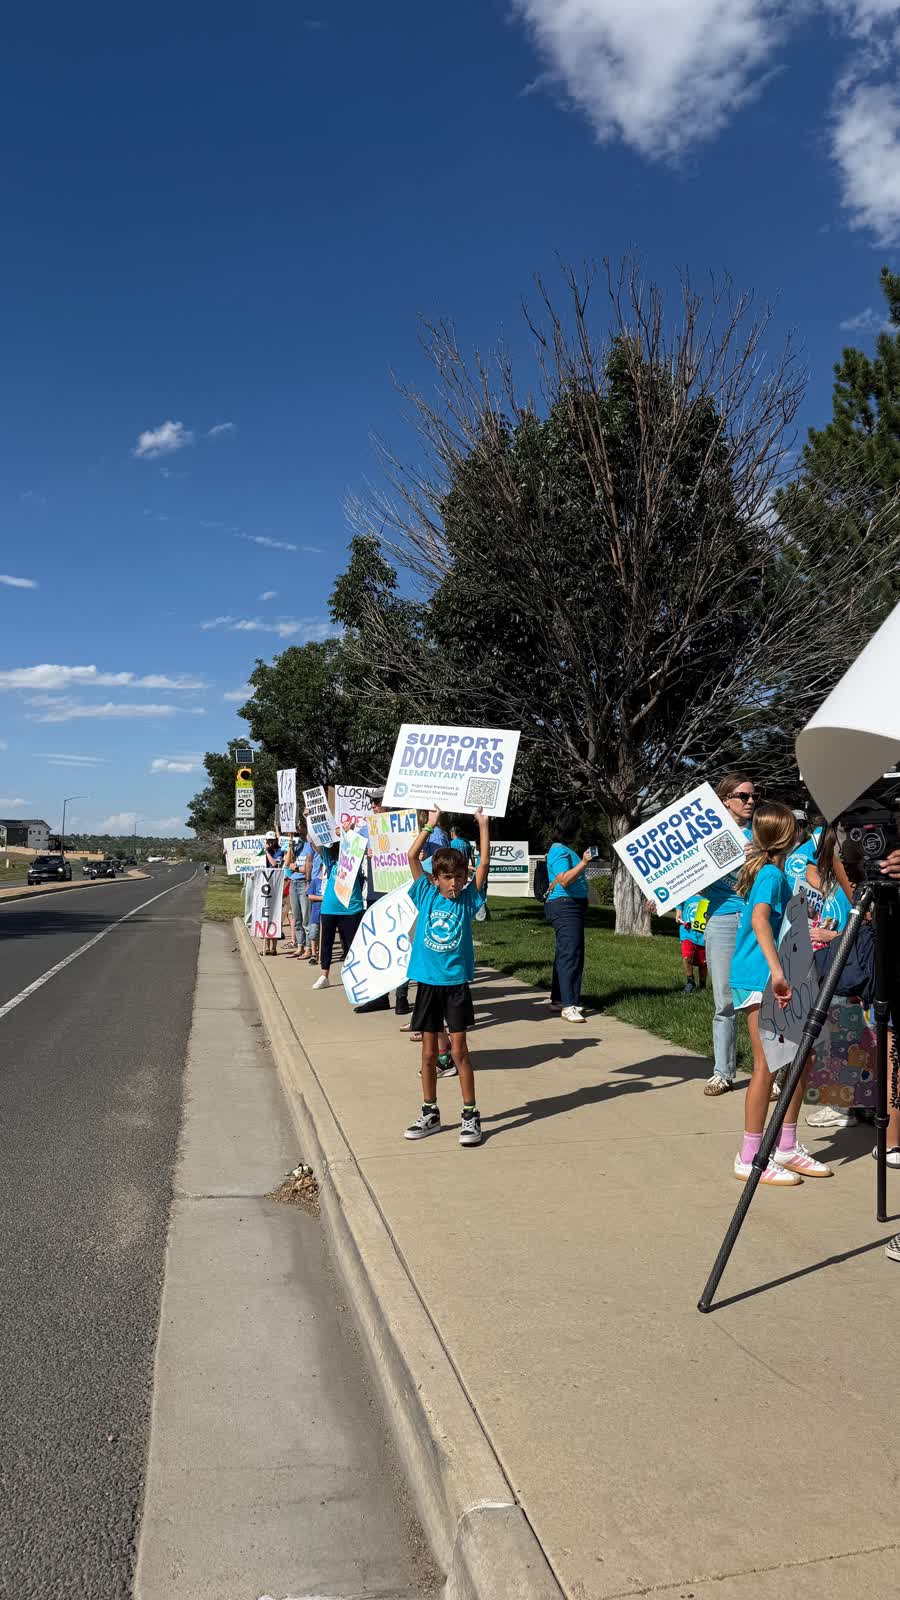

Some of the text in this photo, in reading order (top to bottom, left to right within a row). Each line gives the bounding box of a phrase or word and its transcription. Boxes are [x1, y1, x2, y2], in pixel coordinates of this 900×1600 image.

[406, 732, 504, 751] SUPPORT
[400, 745, 504, 775] DOUGLASS
[398, 768, 465, 780] ELEMENTARY
[306, 788, 322, 799] PUBLIC
[237, 798, 253, 808] 20
[318, 804, 327, 812] FOR
[312, 822, 331, 834] VOTE
[390, 813, 417, 833] FLAT
[625, 798, 705, 856] SUPPORT
[318, 832, 332, 843] NO!
[632, 808, 723, 878] DOUGLASS
[379, 852, 409, 868] CLOSIN
[645, 845, 700, 885] ELEMENTARY
[261, 870, 275, 918] VOTE
[254, 920, 277, 938] NO
